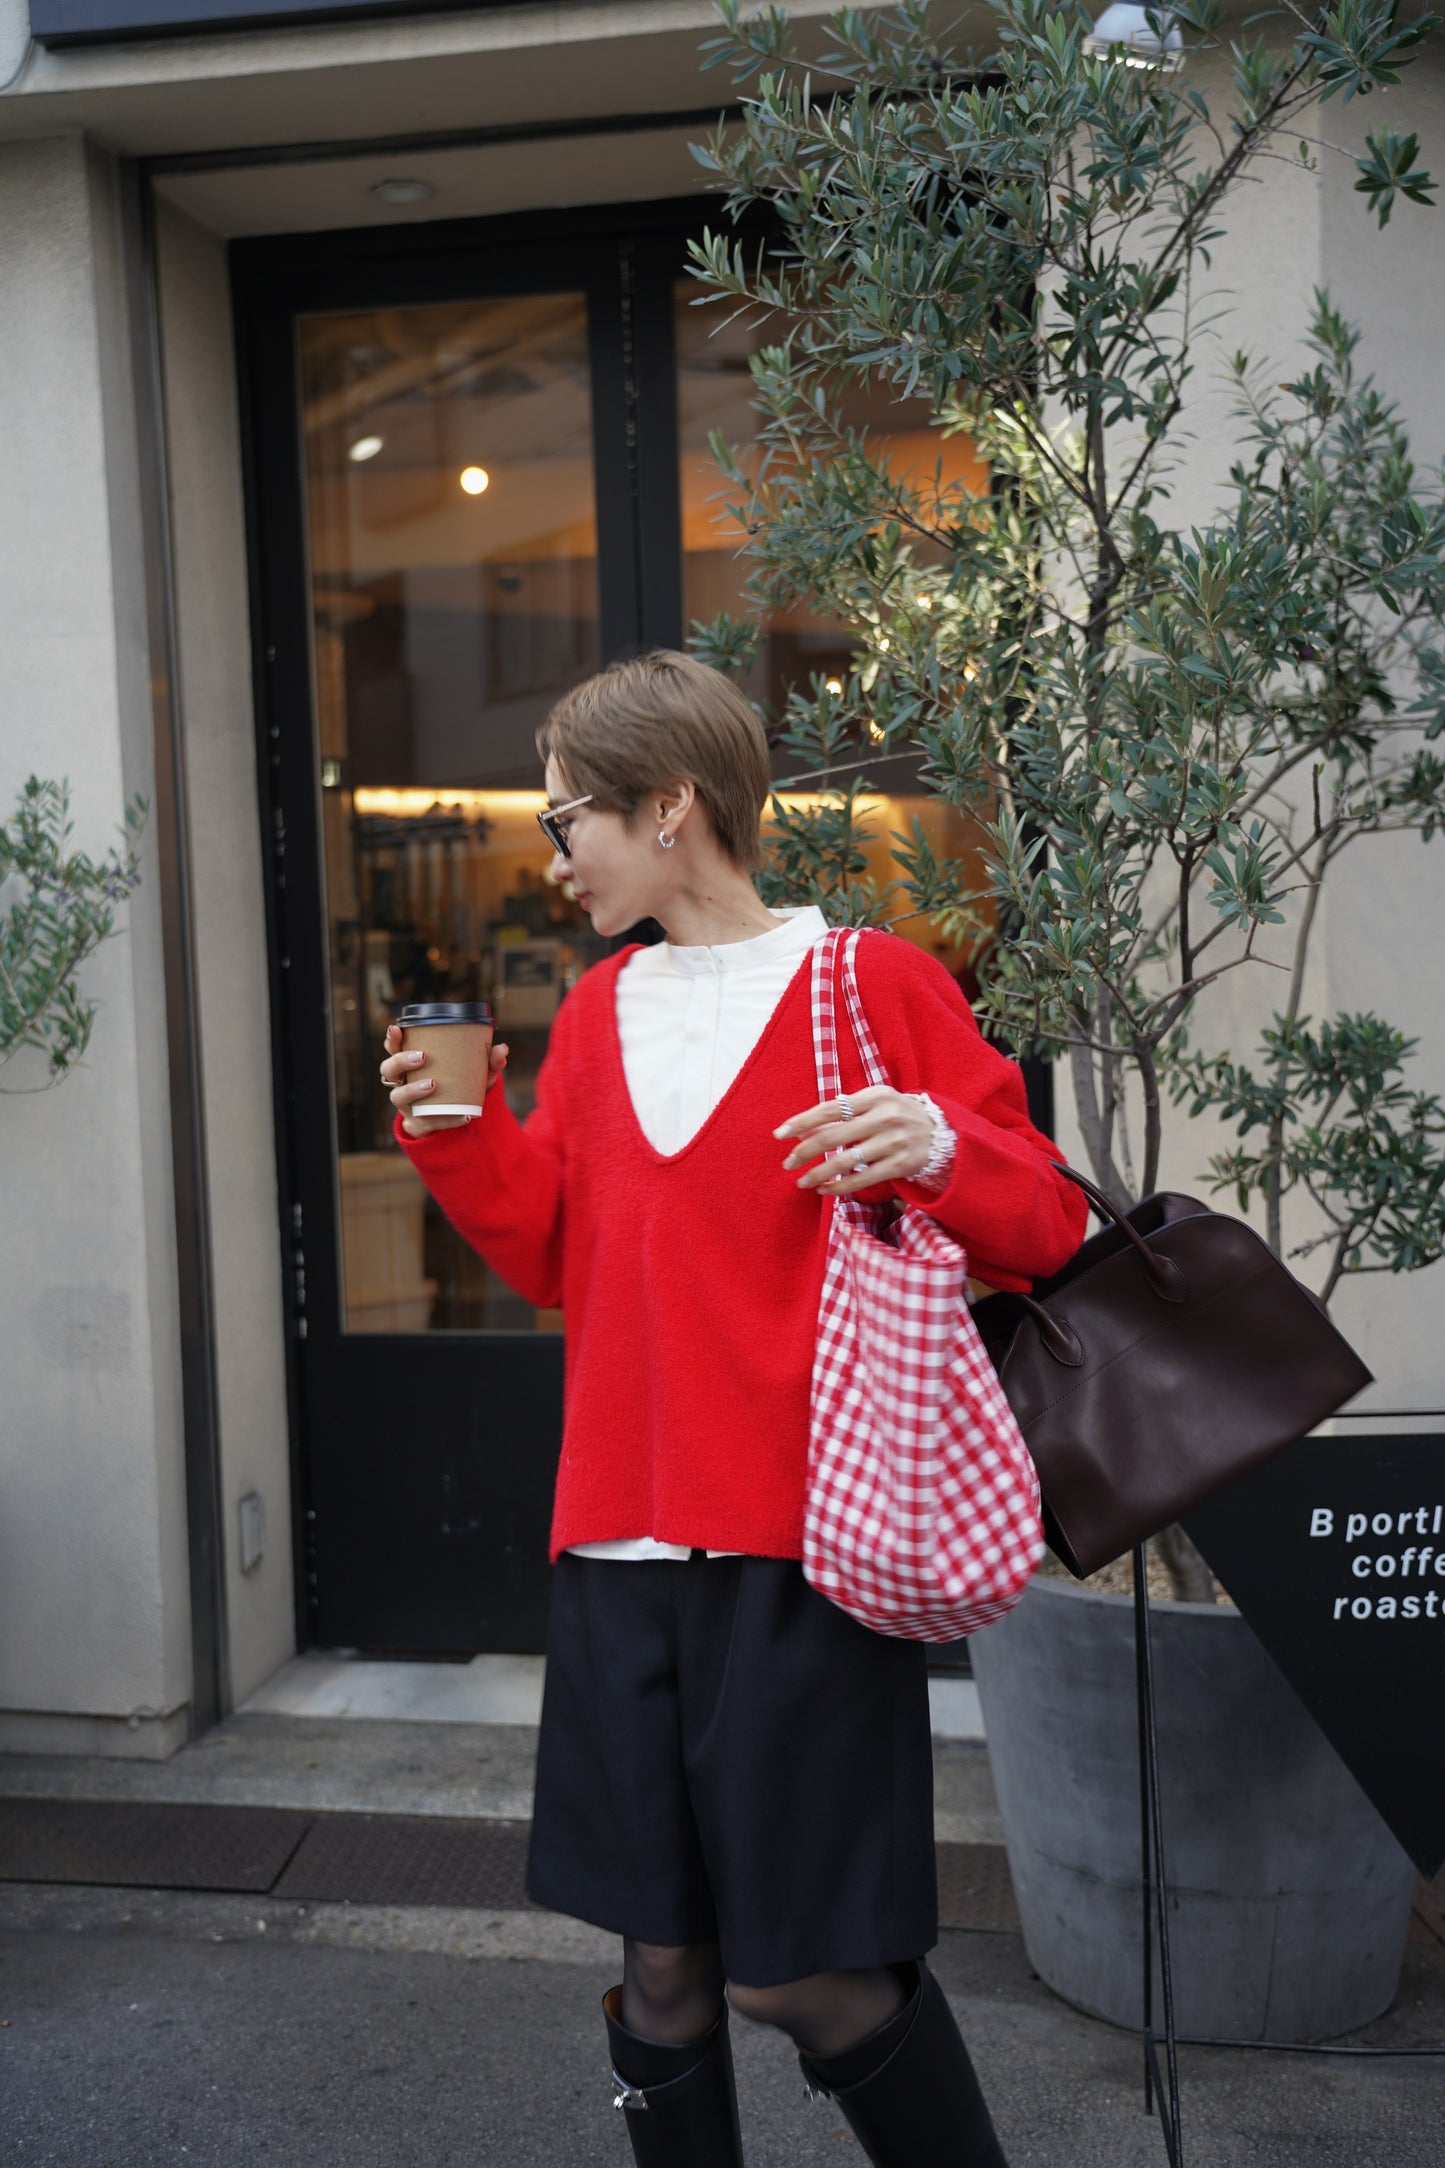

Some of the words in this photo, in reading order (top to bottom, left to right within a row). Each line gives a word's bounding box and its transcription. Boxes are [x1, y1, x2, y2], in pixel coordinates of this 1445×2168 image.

[1309, 1508, 1334, 1537] B
[1345, 1504, 1443, 1543] portl
[1333, 1590, 1445, 1620] roast
